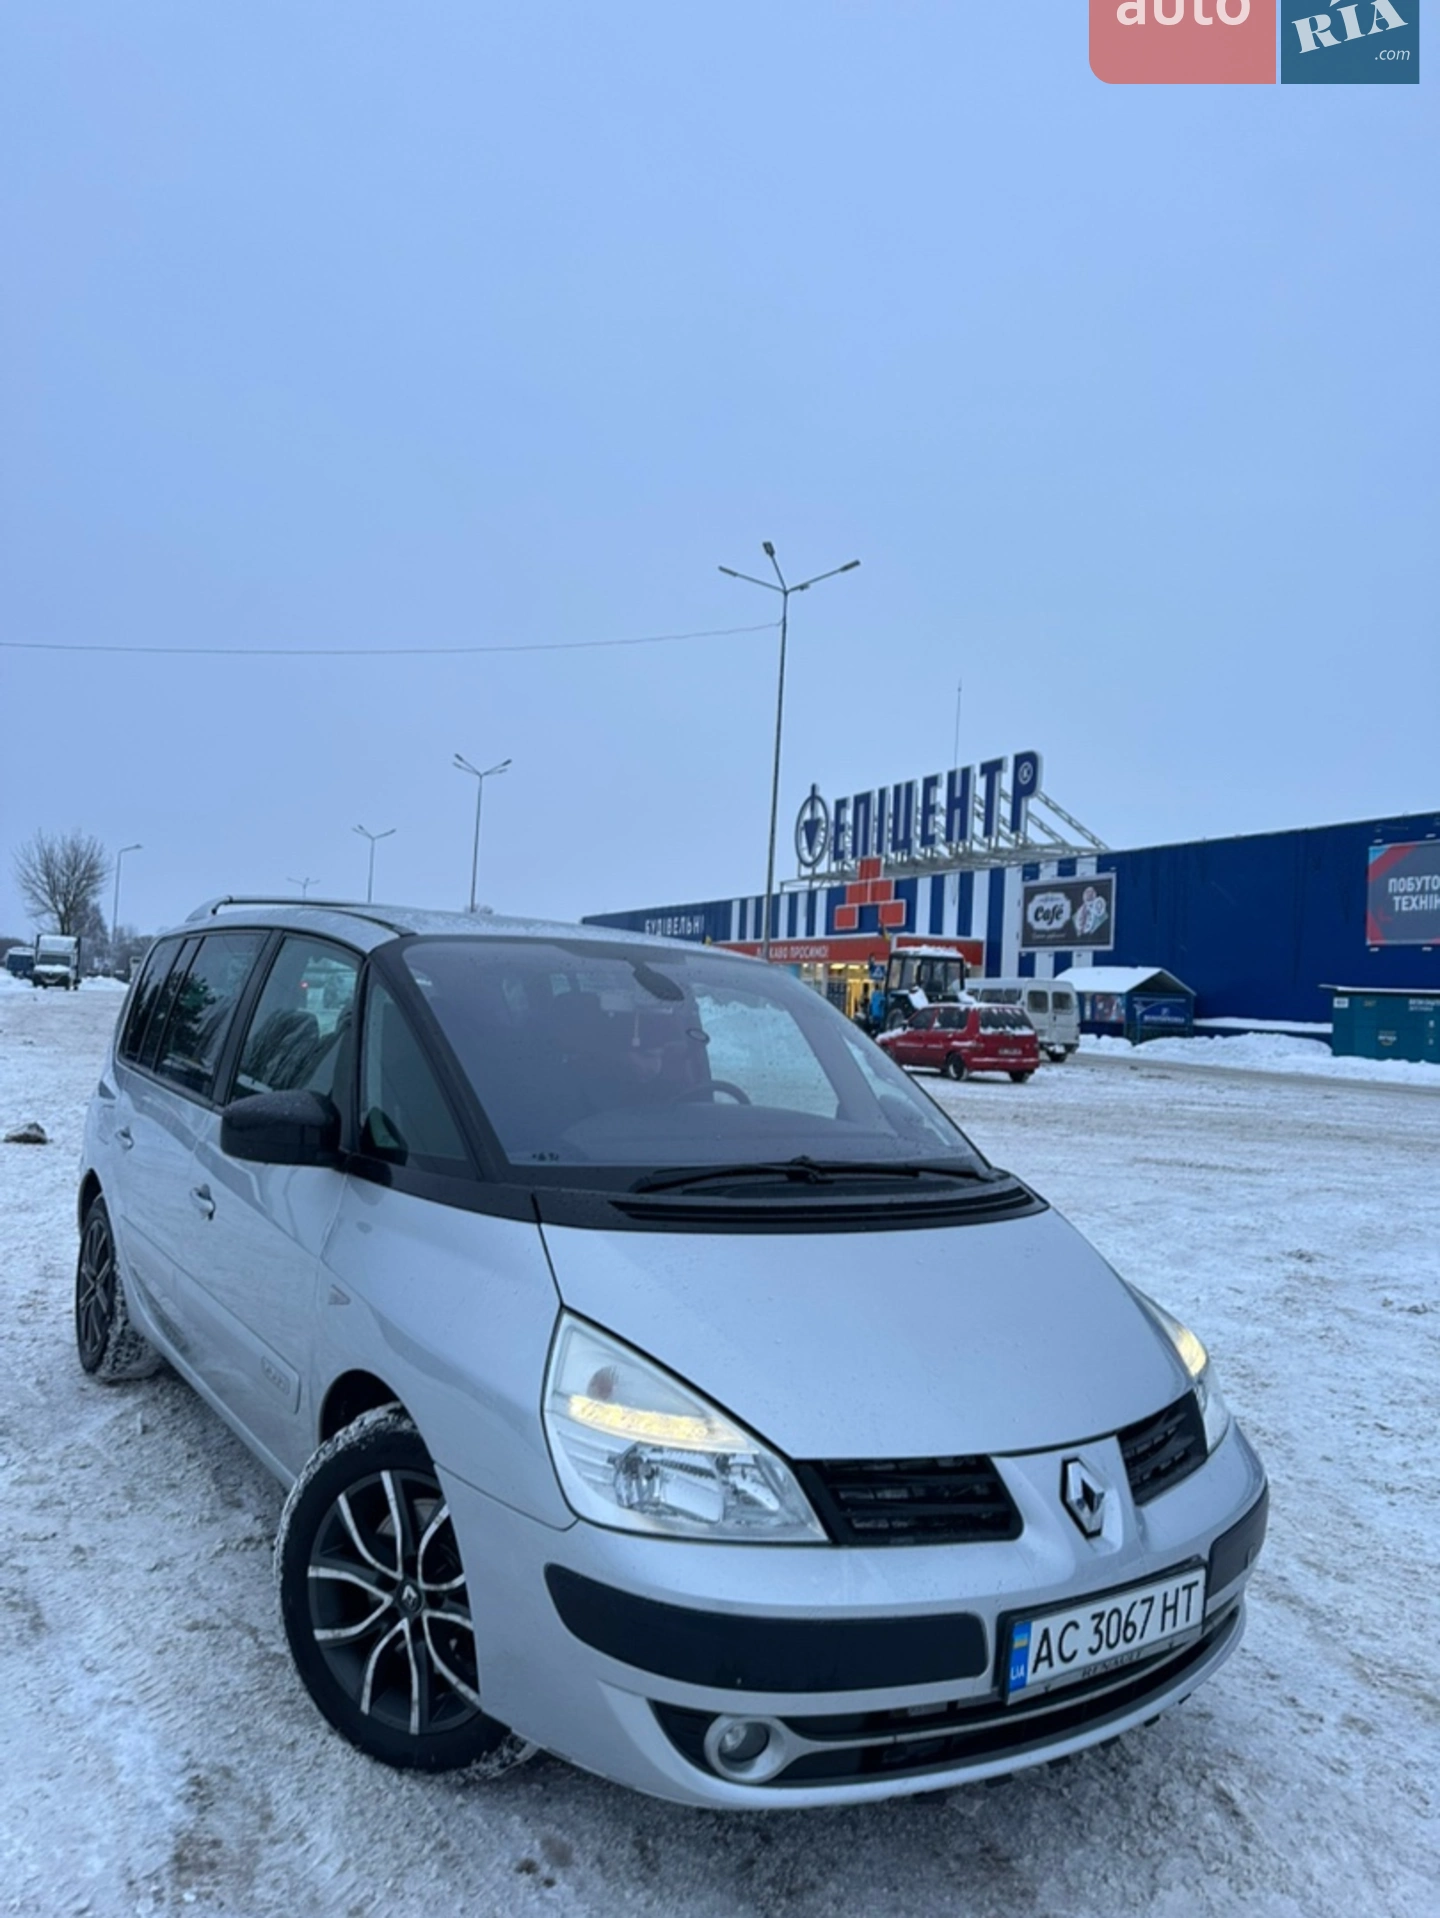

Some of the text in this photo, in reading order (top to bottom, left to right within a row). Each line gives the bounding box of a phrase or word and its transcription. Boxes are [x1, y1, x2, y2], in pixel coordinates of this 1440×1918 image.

[832, 750, 1041, 862] ЕПІЦЕНТР
[1032, 1620, 1080, 1674] AC
[1087, 1596, 1154, 1655] 3067
[1161, 1581, 1199, 1633] HT
